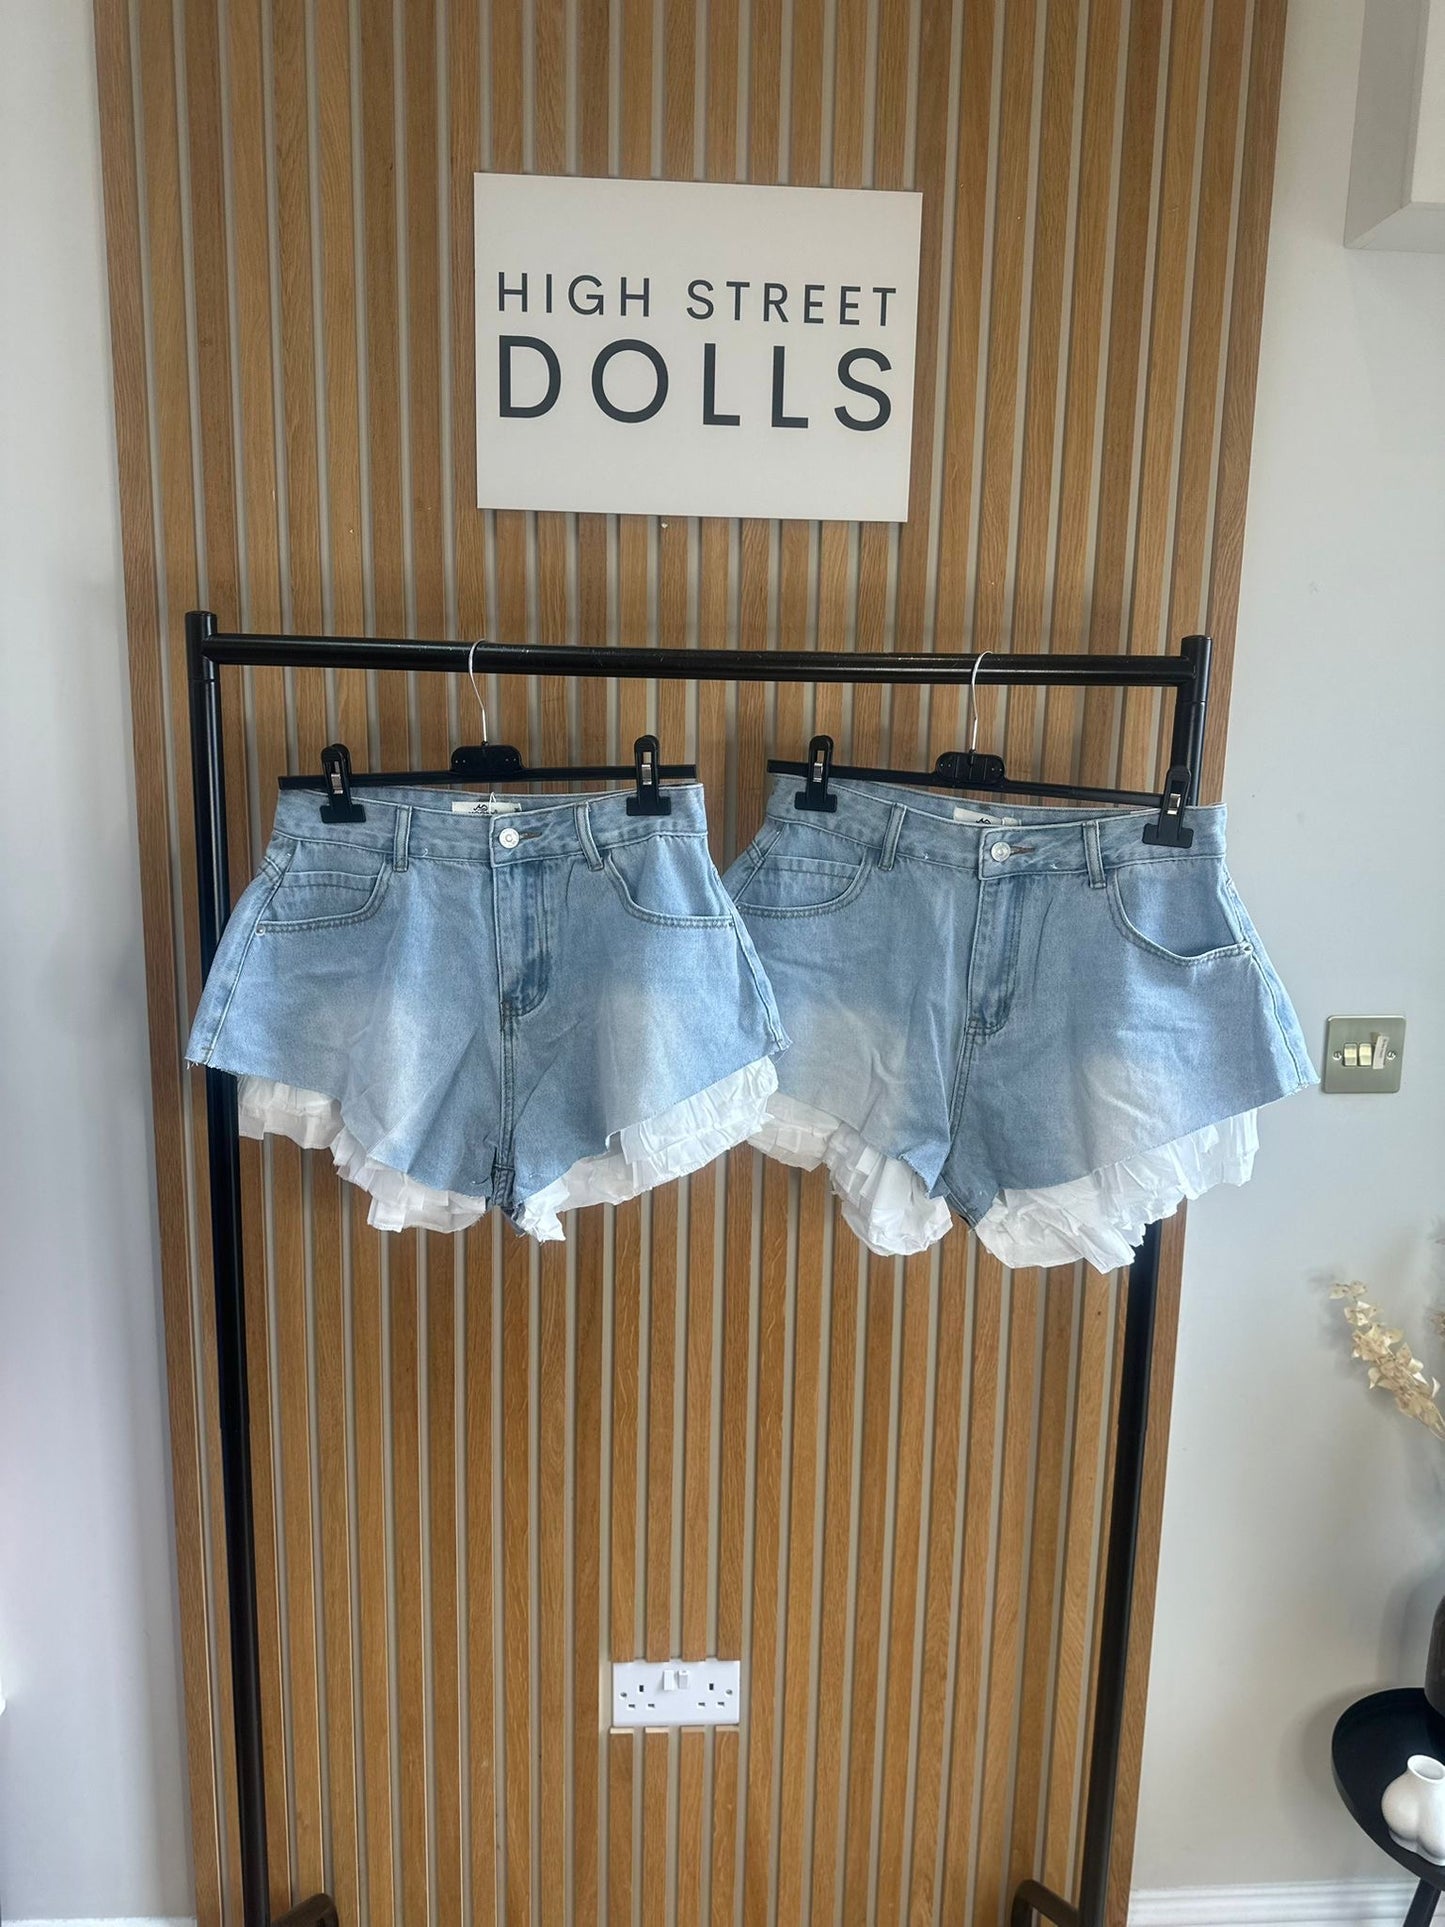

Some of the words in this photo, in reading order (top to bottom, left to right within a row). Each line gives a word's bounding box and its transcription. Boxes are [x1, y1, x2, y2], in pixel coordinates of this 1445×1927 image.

[498, 271, 650, 318] HIGH
[686, 279, 897, 327] STREET
[498, 334, 892, 432] DOLLS
